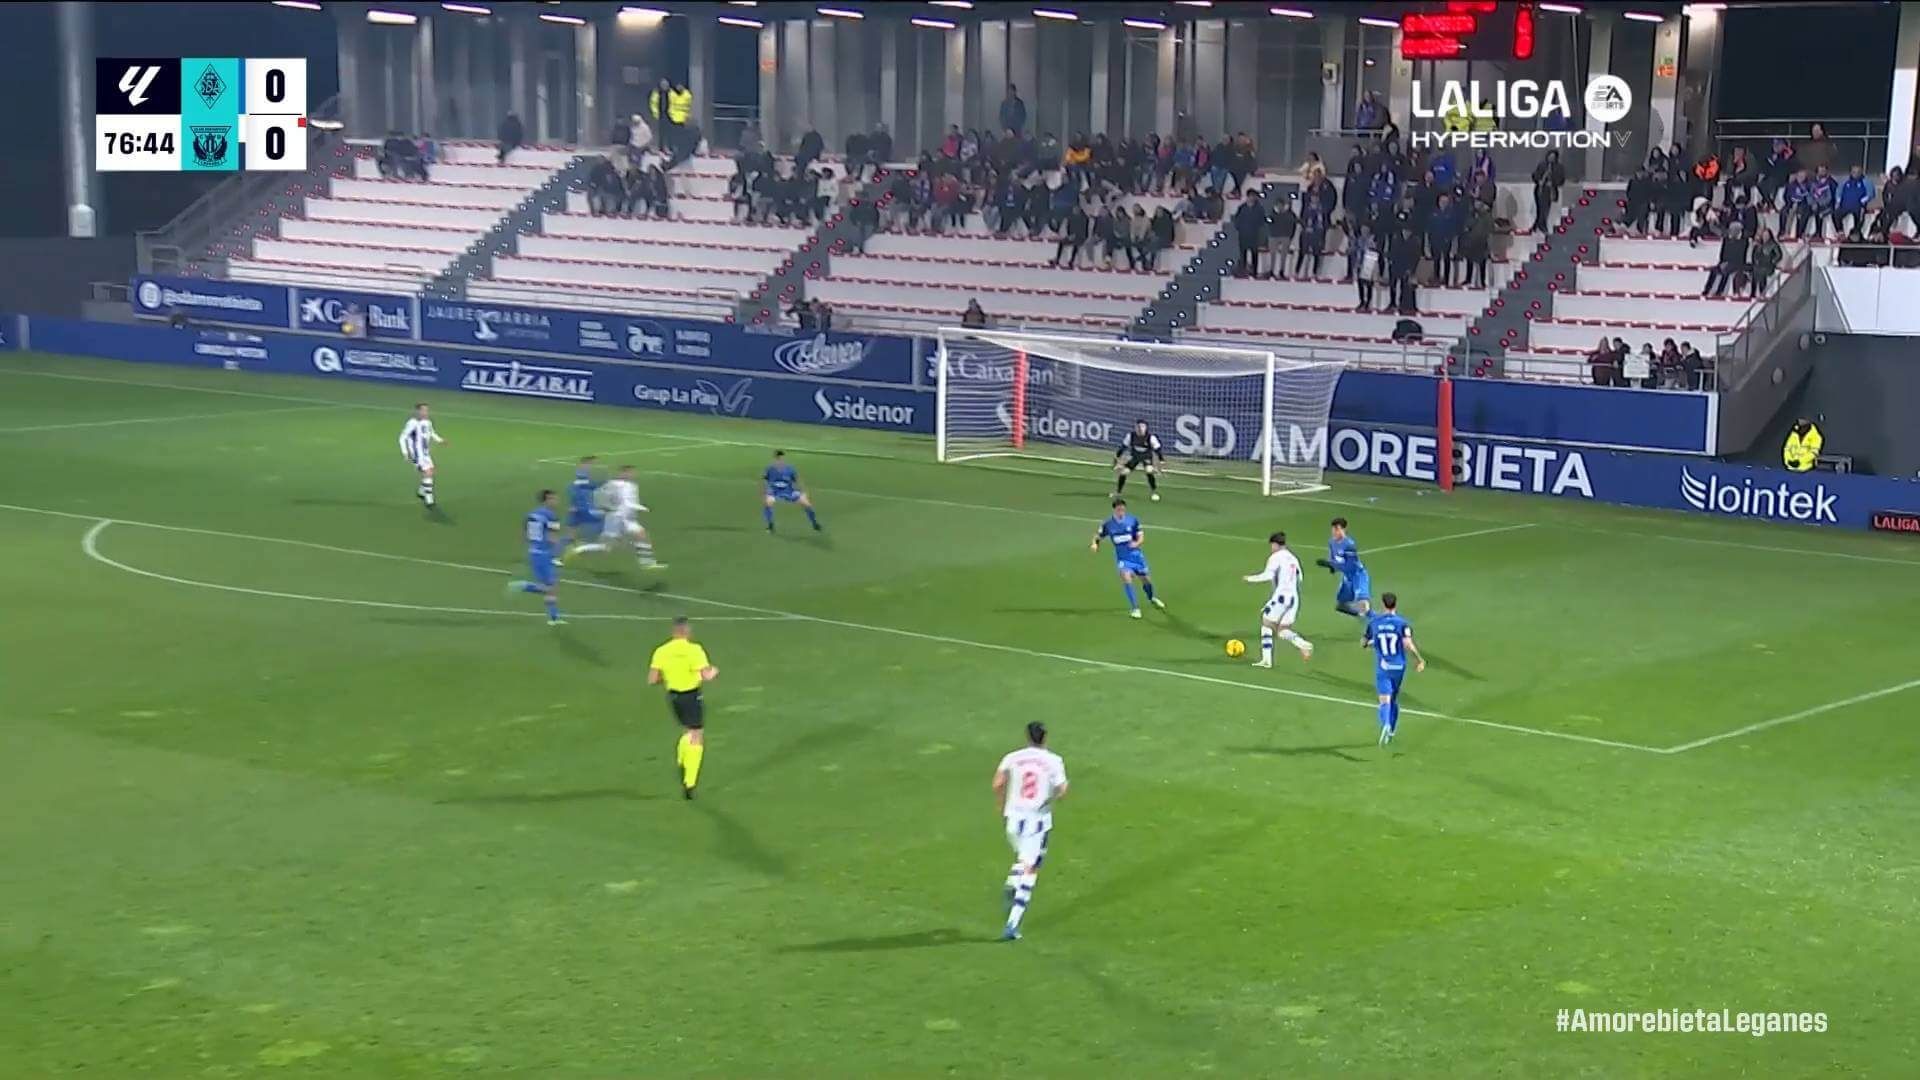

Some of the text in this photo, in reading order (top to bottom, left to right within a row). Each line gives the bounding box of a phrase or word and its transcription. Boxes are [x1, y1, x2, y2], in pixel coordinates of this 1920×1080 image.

[323, 299, 410, 331] CBank
[958, 353, 1066, 386] Caixaank
[834, 395, 914, 425] sidenor
[1023, 408, 1113, 442] idenor
[1174, 413, 1595, 498] SD AMOREBIETA
[1709, 475, 1837, 522] lointek
[1874, 514, 1920, 531] LALIGA
[1377, 632, 1399, 656] 17
[1021, 770, 1037, 800] 8
